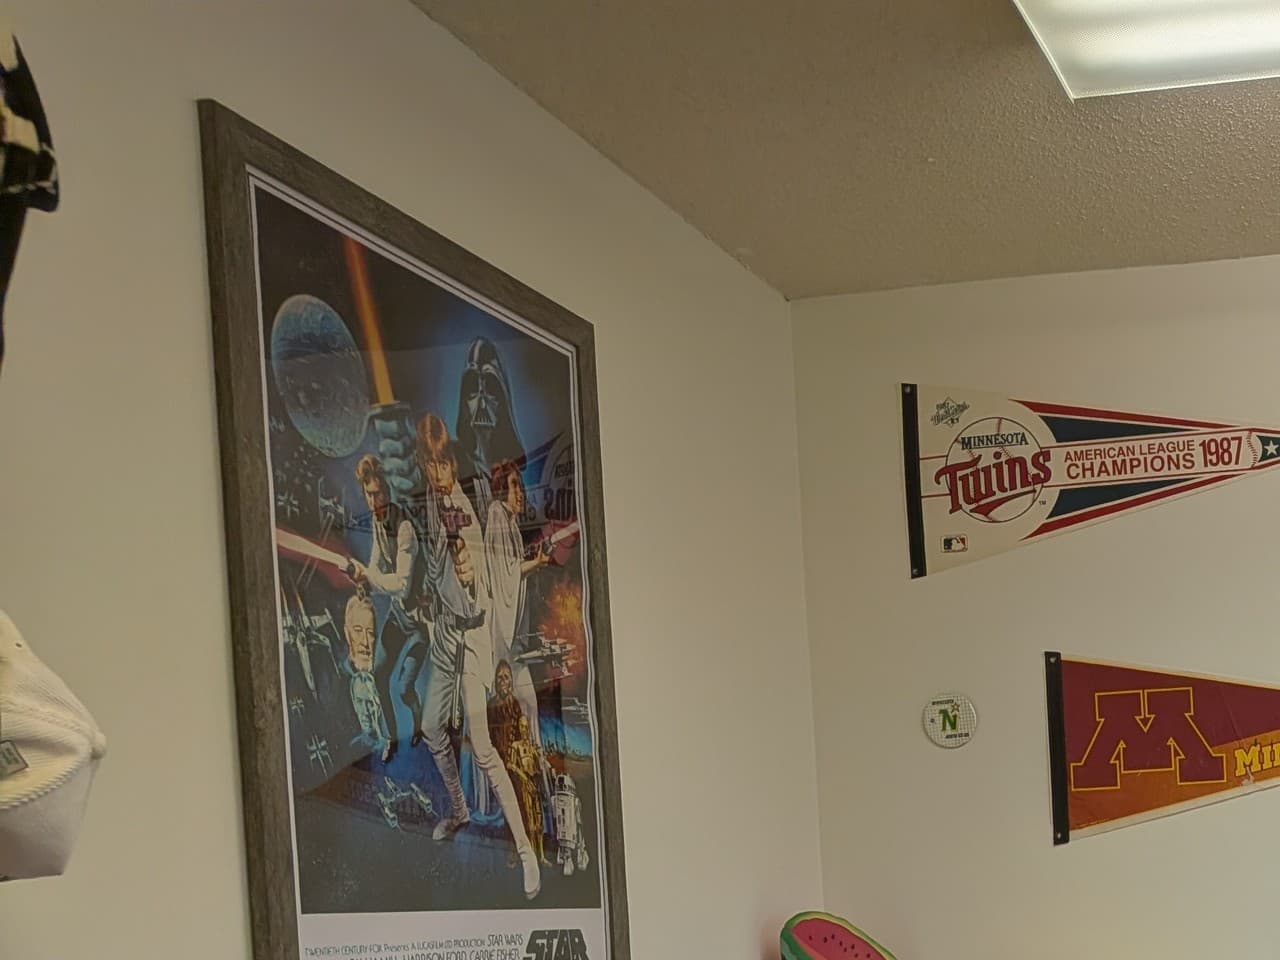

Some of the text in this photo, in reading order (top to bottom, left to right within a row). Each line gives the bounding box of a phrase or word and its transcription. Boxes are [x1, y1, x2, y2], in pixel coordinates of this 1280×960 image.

[961, 432, 1029, 450] MINNESOTA
[1064, 439, 1195, 462] AMERICAN LEAGUE
[1199, 436, 1243, 468] 1987
[1066, 453, 1195, 480] CHAMPIONS
[933, 449, 1052, 515] Twins
[939, 709, 958, 731] N
[1070, 687, 1227, 792] M
[487, 934, 503, 947] STAR
[504, 933, 523, 946] WARS
[496, 948, 520, 960] FISHER
